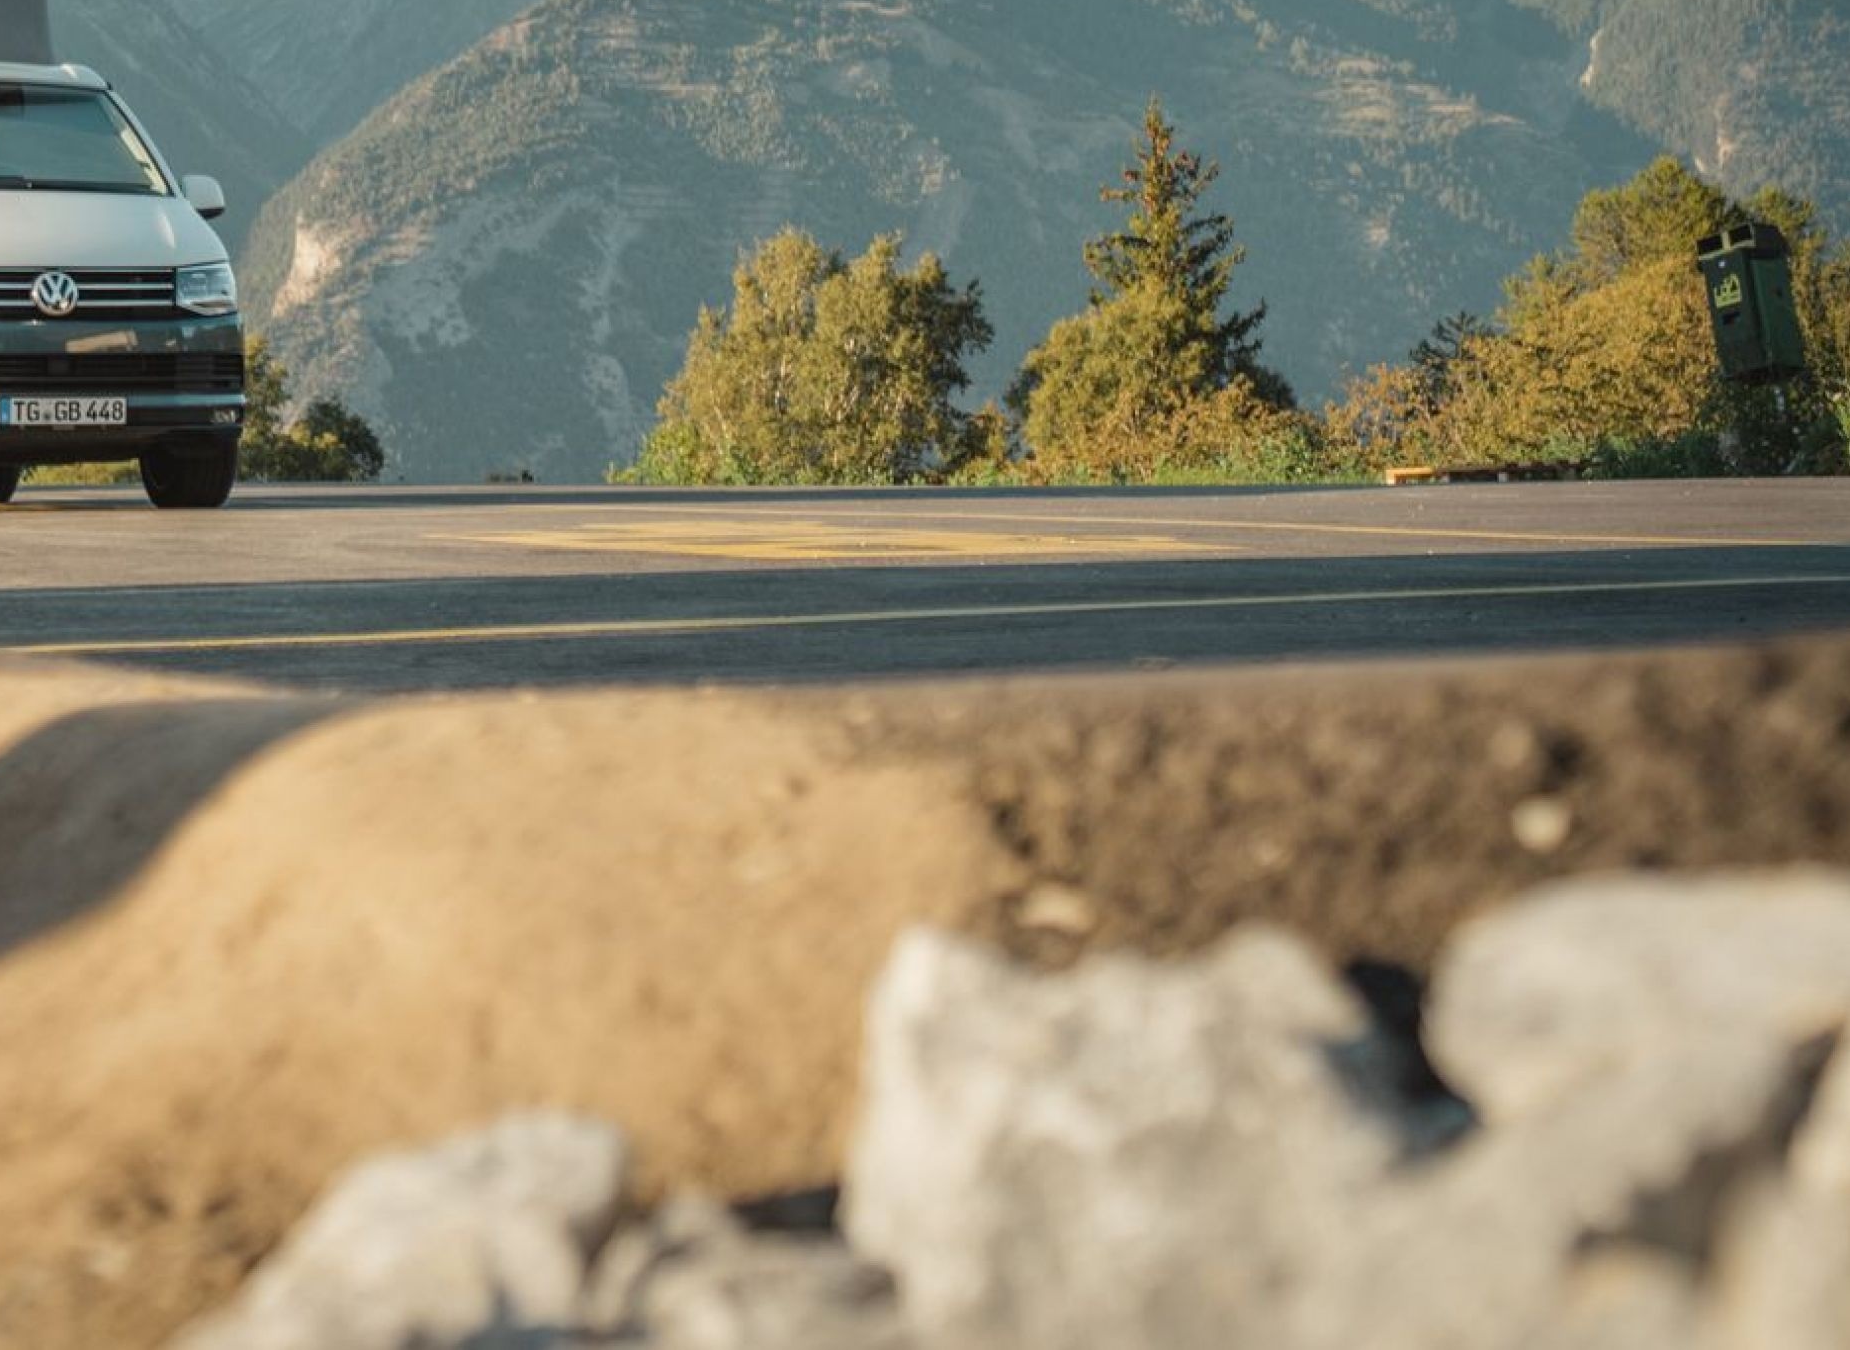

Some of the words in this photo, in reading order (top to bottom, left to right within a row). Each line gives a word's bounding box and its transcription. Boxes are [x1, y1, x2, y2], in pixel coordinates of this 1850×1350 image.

[33, 272, 77, 316] VW
[13, 400, 40, 421] TG
[54, 400, 81, 421] GB
[86, 400, 124, 421] 448
